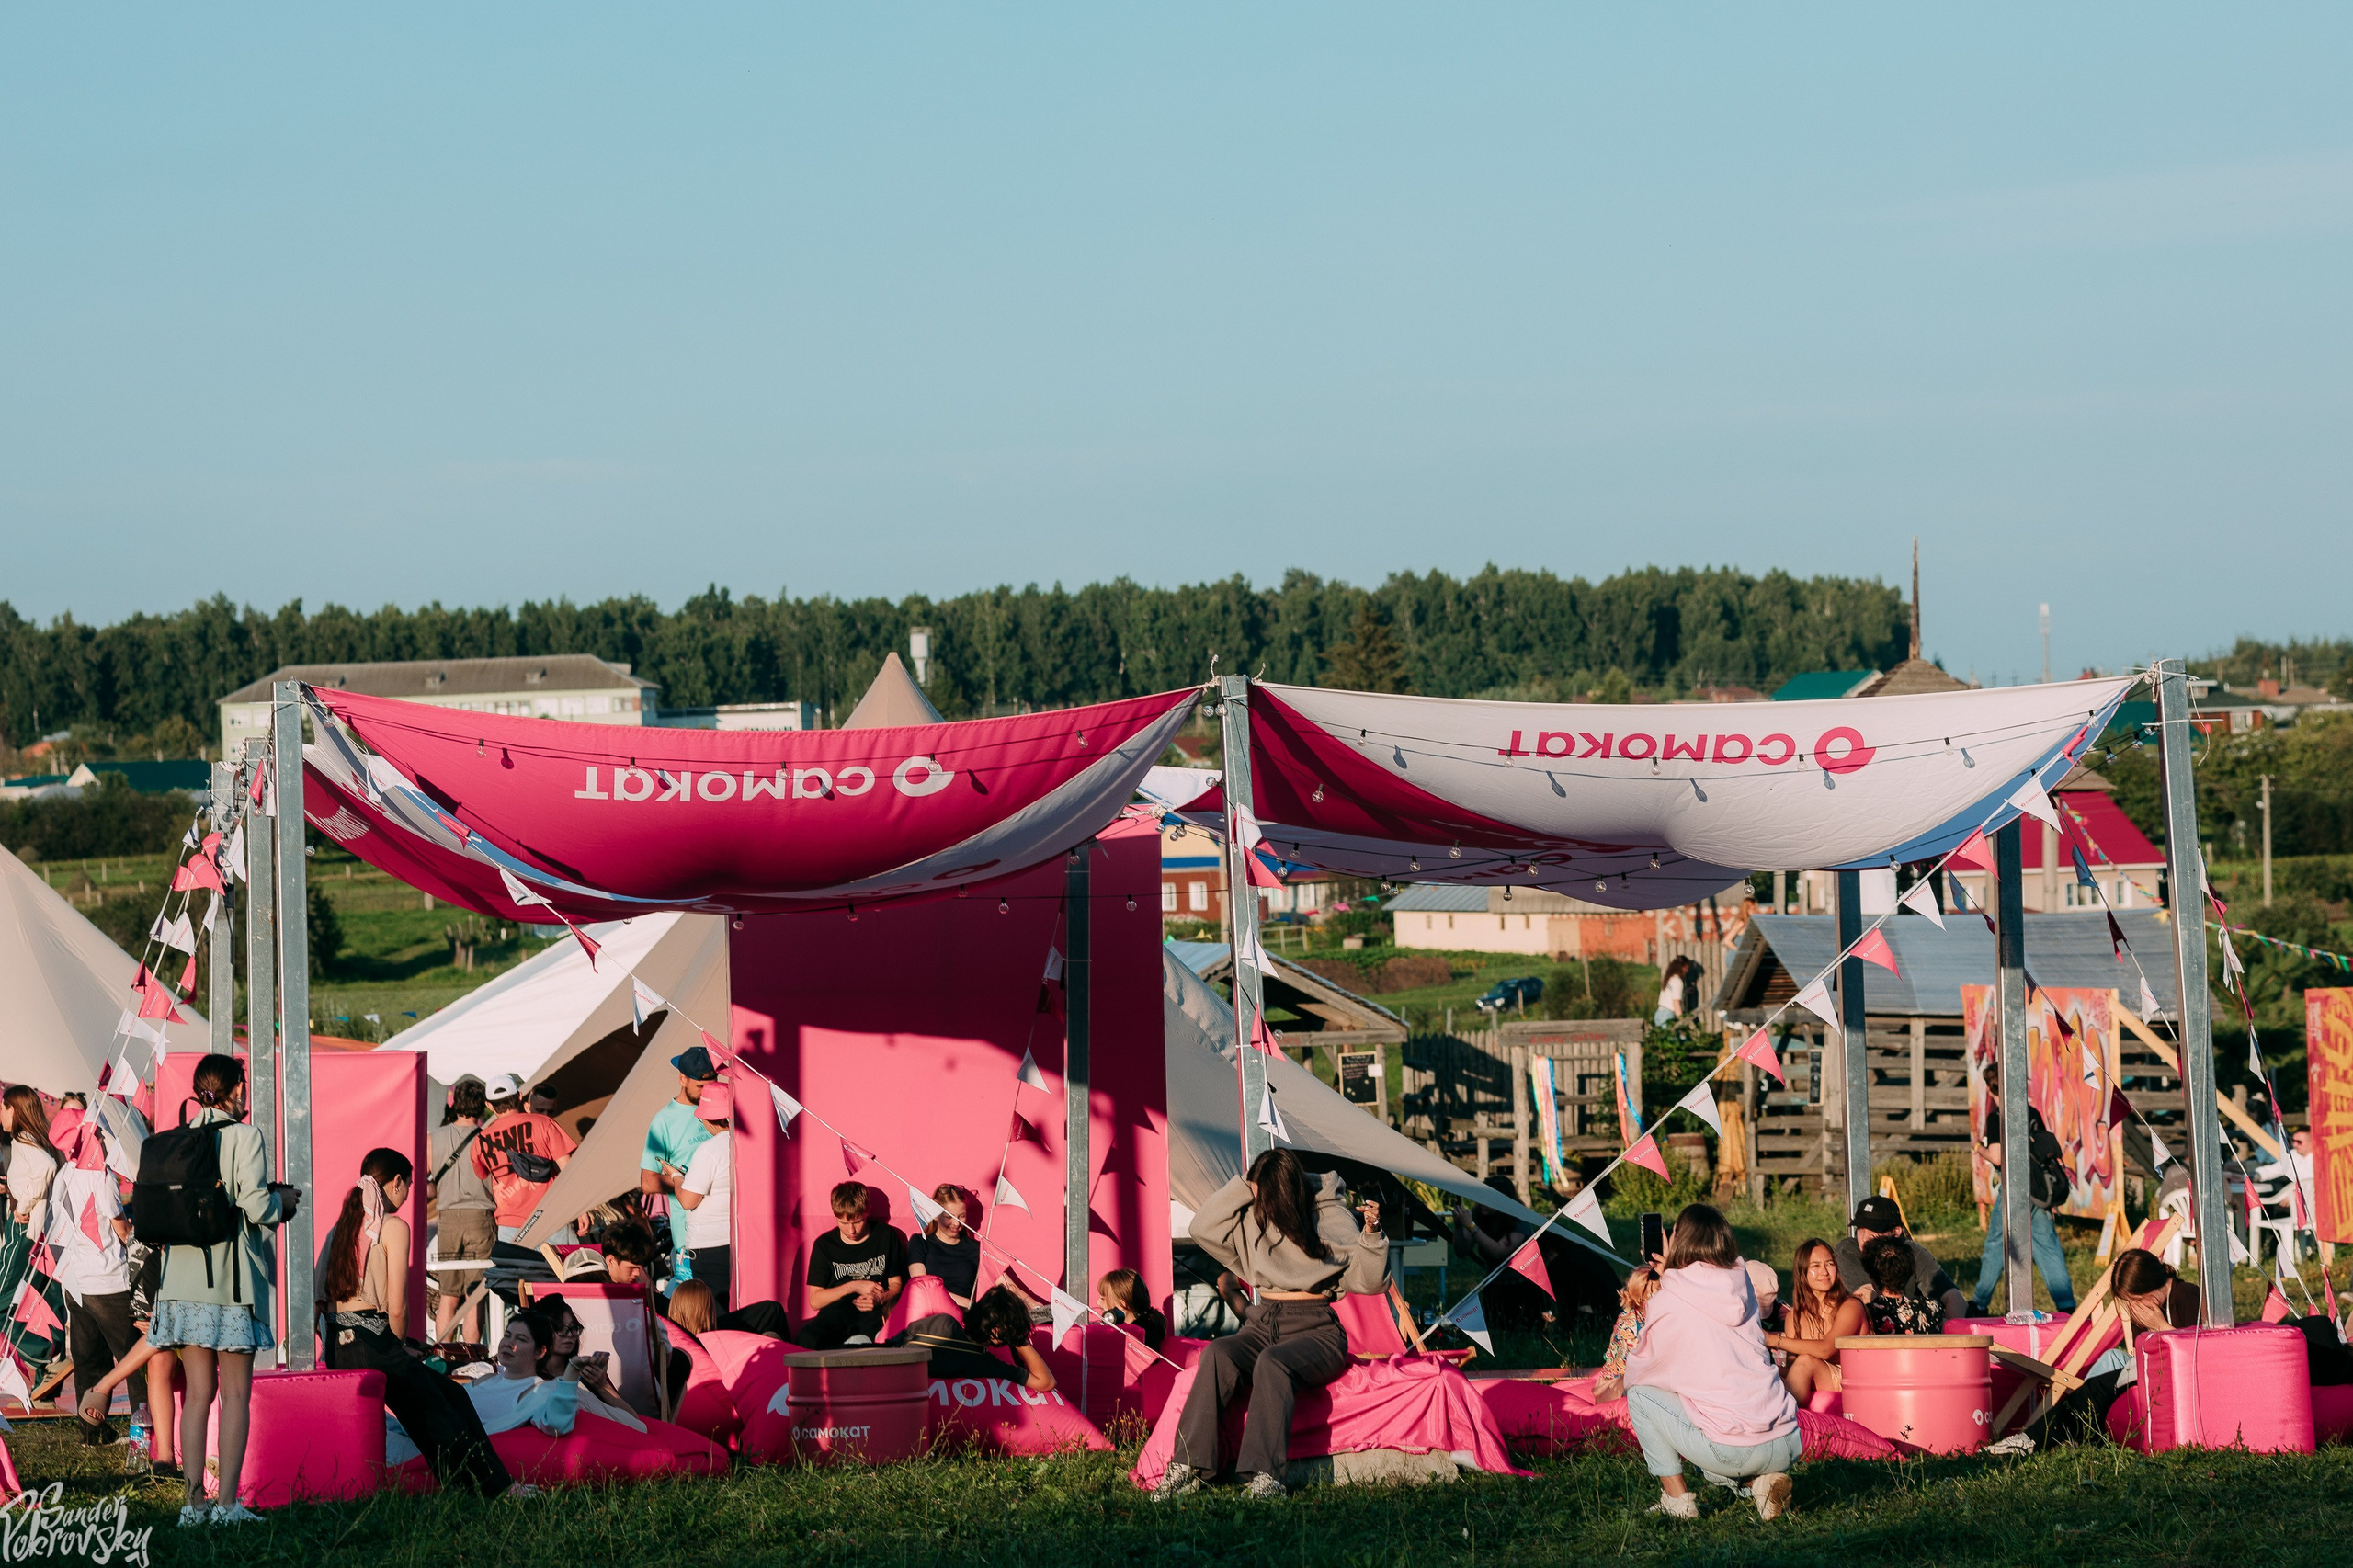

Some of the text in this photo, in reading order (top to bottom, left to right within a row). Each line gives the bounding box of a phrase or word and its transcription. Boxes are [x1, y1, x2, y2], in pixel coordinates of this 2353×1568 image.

[1498, 730, 1796, 766] самокат
[574, 766, 876, 801] самокат
[688, 1133, 714, 1146] SARCA
[801, 1426, 870, 1440] самокат
